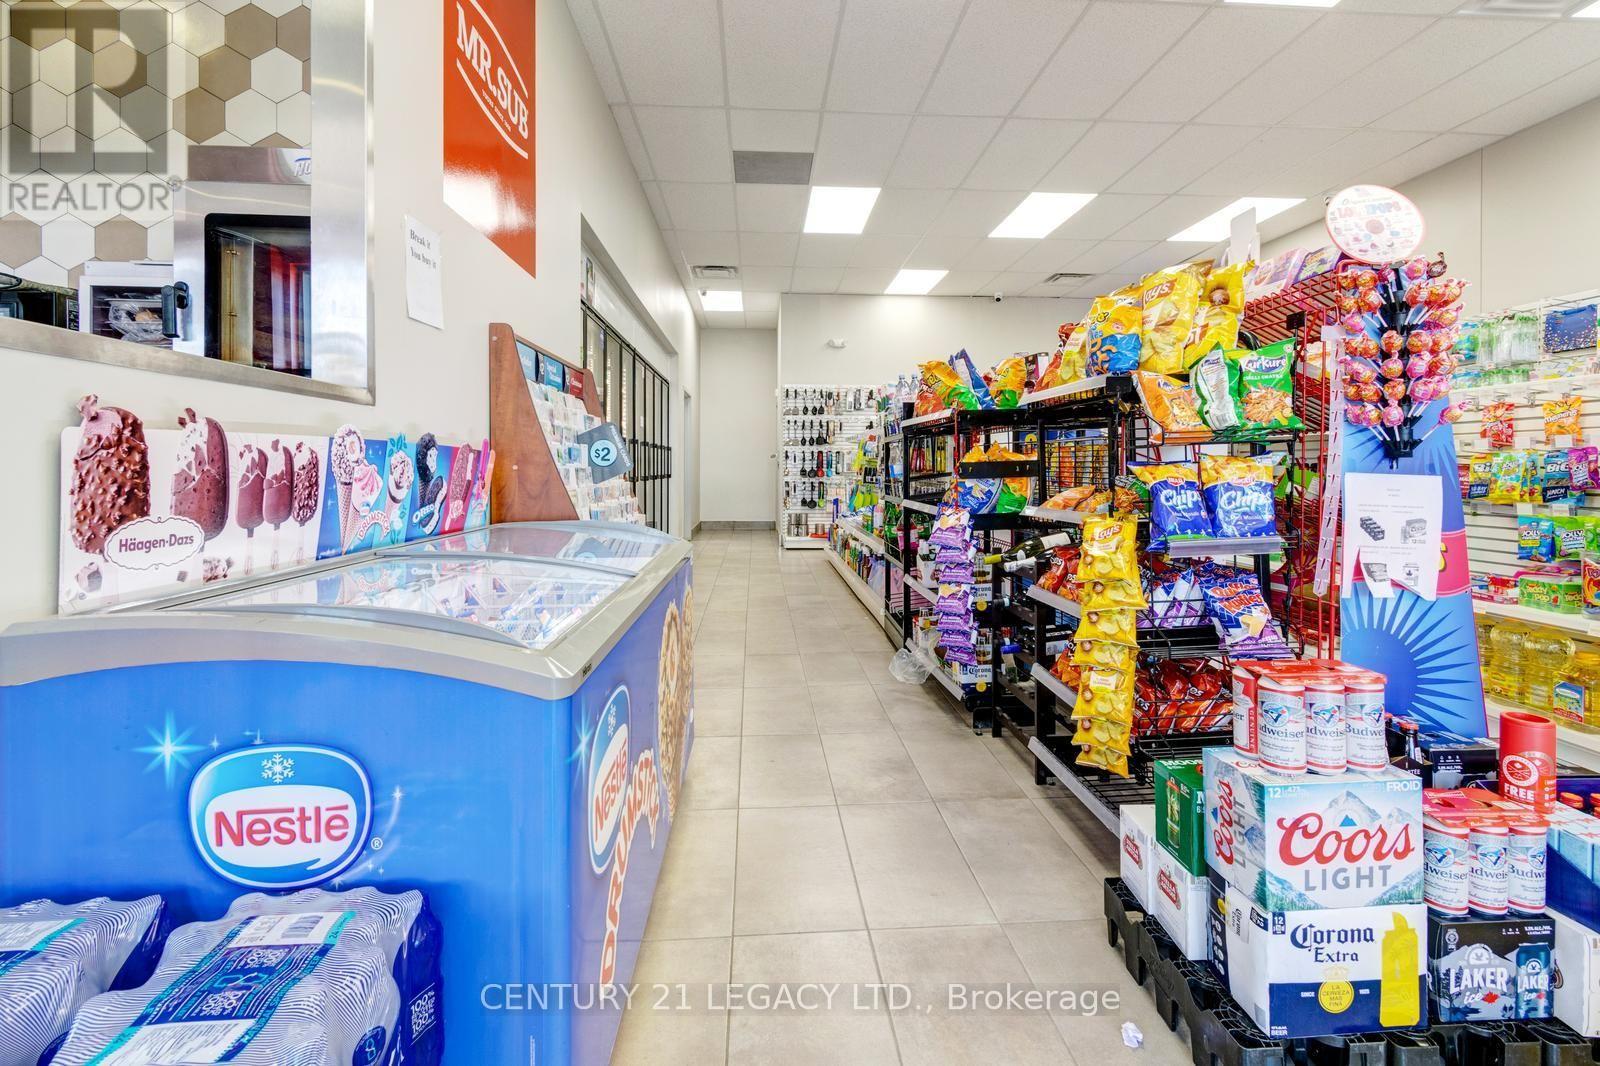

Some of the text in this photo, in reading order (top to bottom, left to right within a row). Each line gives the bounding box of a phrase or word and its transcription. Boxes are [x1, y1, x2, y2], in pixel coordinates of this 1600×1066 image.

[410, 229, 426, 249] Break
[410, 246, 421, 261] You
[594, 446, 611, 461] $2
[1268, 787, 1281, 799] 12
[1386, 780, 1421, 793] FROID
[1504, 782, 1535, 803] FREE
[214, 804, 350, 847] Nestlé
[1276, 812, 1416, 867] Coors
[1304, 864, 1393, 892] LIGHT
[1273, 916, 1284, 926] 12
[1290, 923, 1376, 952] Corona
[1314, 947, 1359, 963] Extra
[1450, 967, 1508, 994] LAKER
[1517, 974, 1549, 992] LAKER
[1463, 991, 1483, 1005] ice
[1523, 991, 1537, 1001] ice
